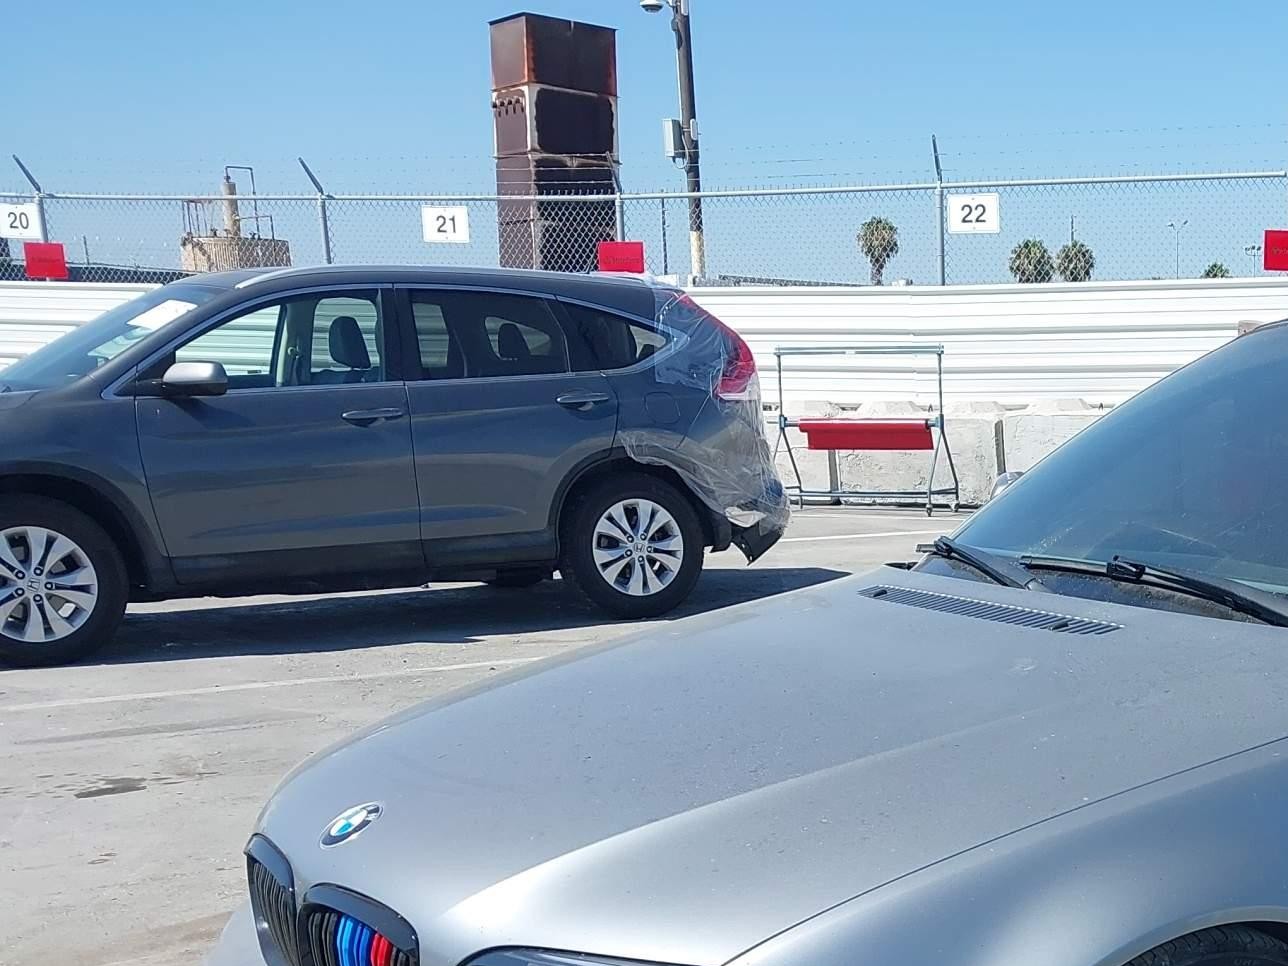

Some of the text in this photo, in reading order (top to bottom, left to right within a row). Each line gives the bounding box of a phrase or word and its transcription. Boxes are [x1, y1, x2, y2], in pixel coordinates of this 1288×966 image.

[8, 212, 29, 229] 20
[961, 204, 986, 223] 22
[436, 215, 456, 233] 21
